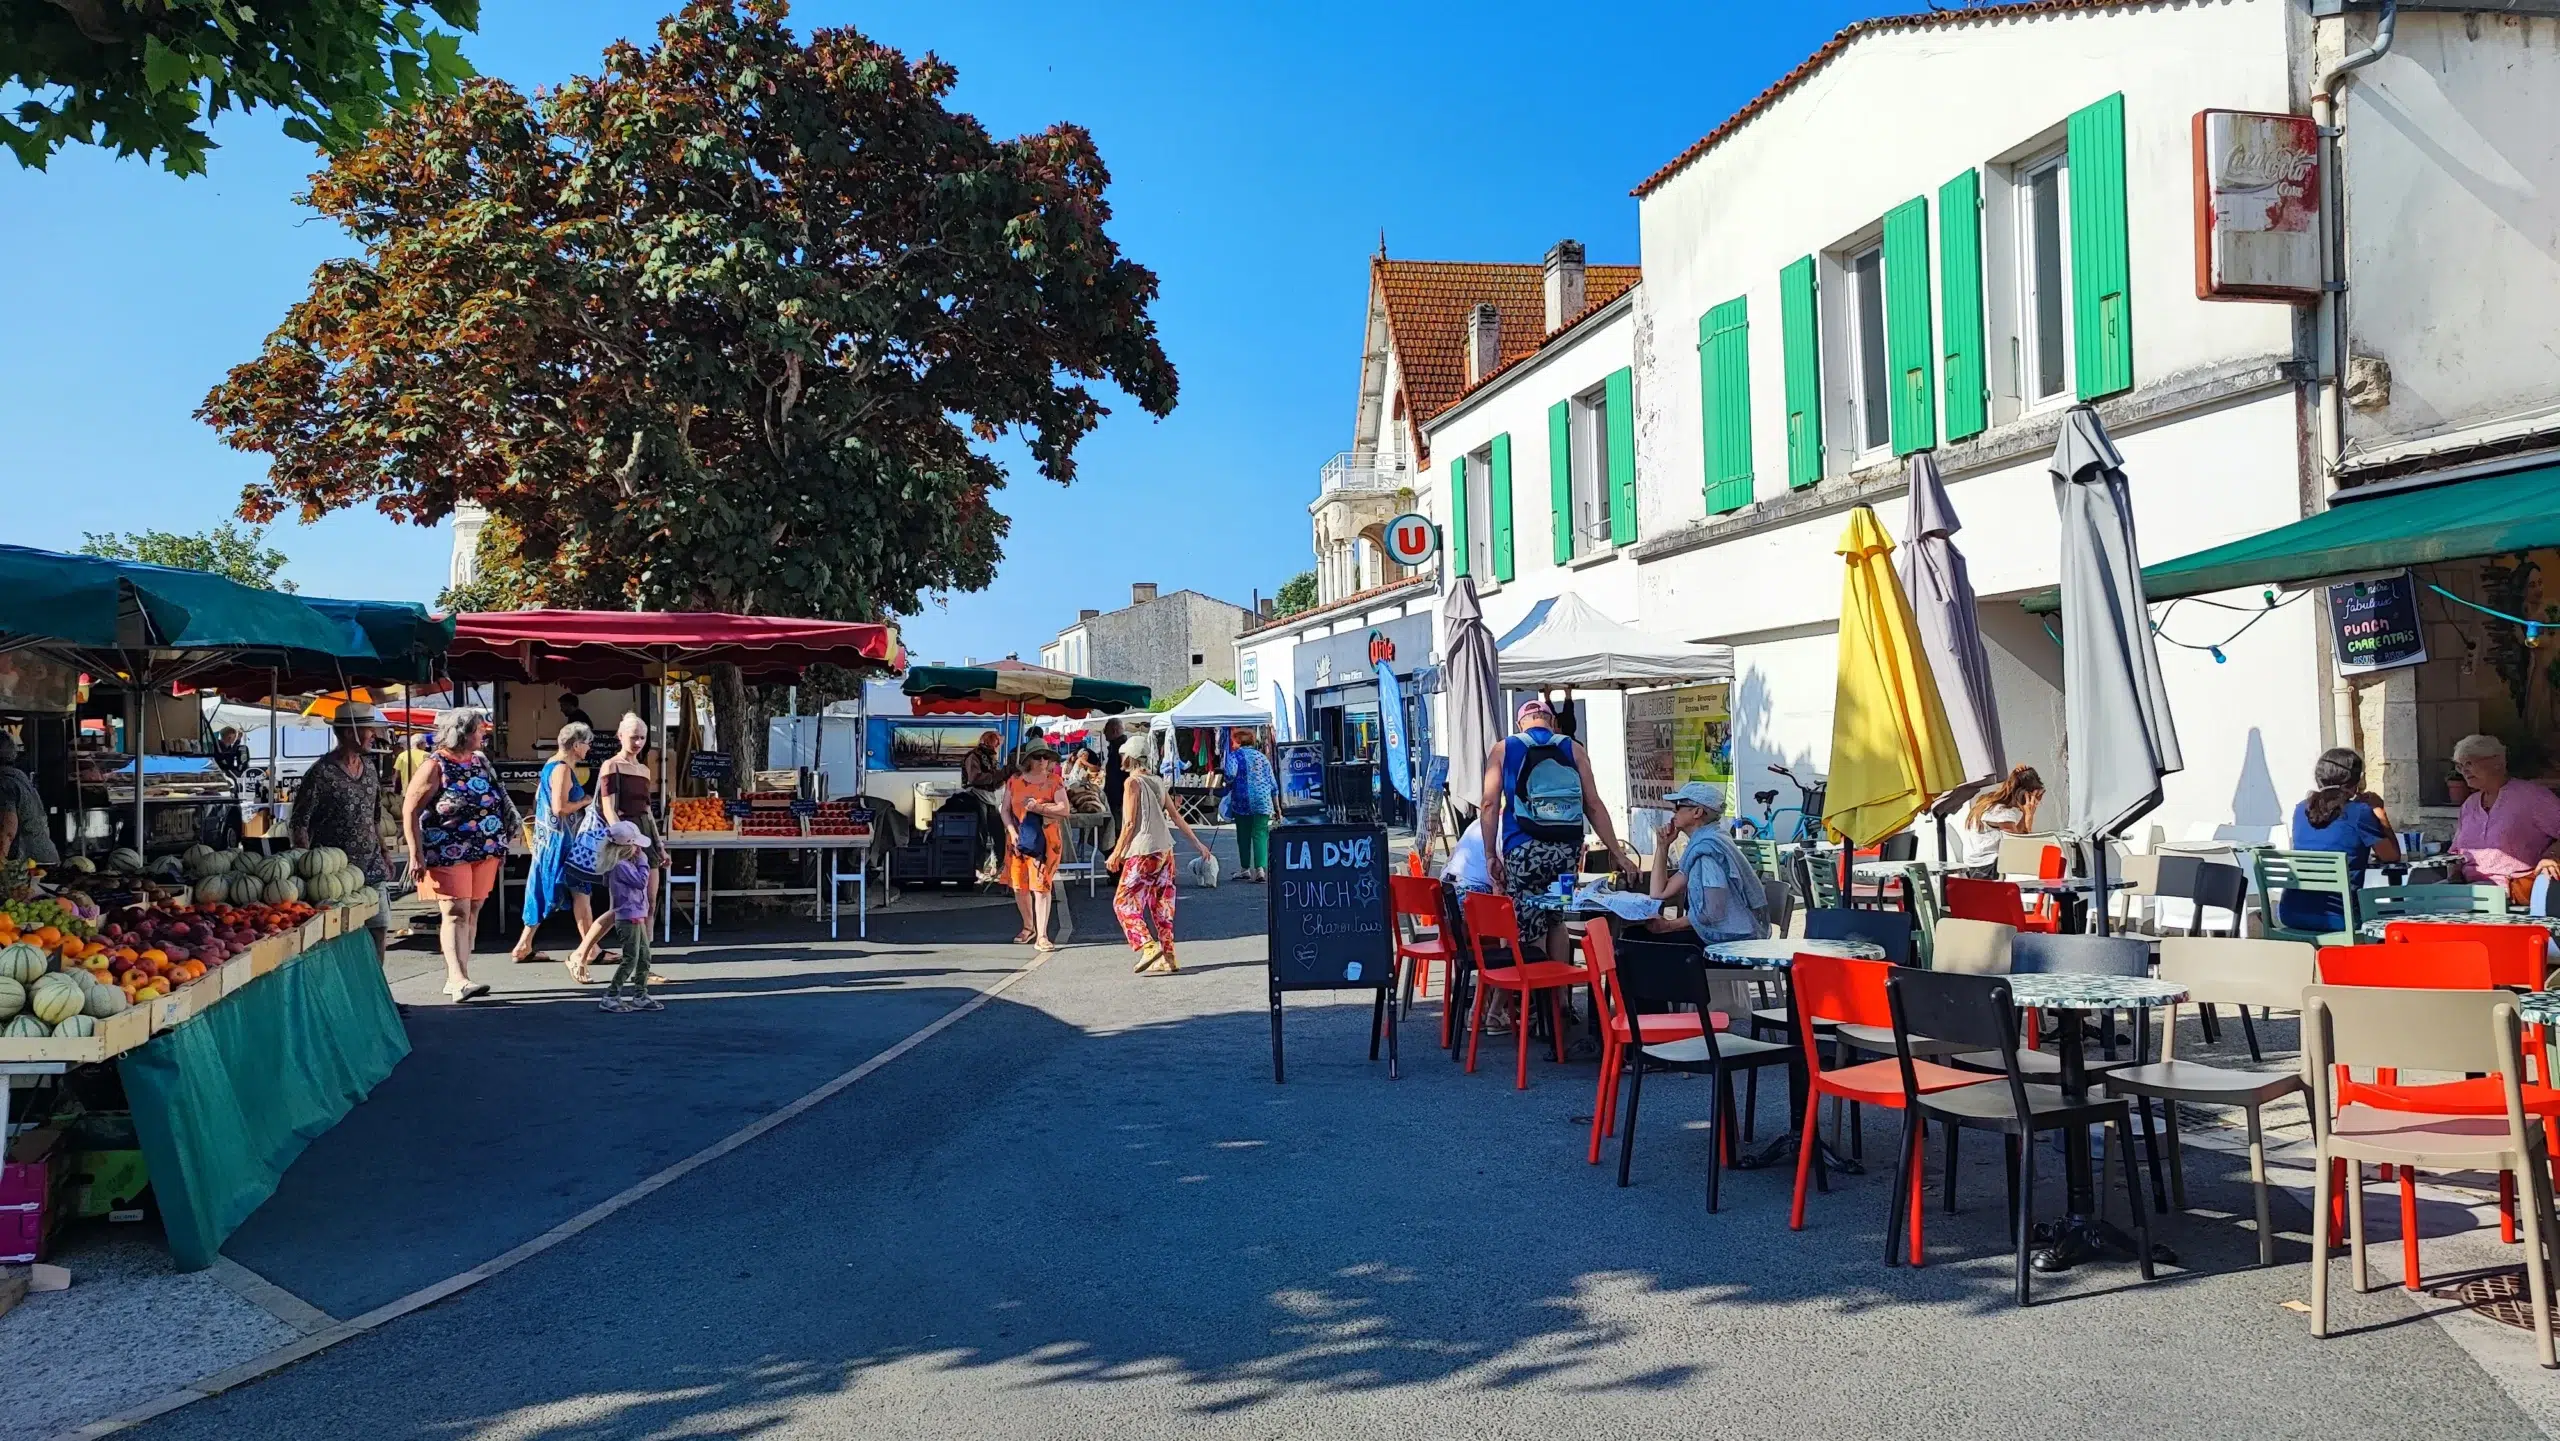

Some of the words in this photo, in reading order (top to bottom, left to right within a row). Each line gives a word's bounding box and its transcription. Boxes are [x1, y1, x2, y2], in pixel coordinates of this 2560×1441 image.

[1398, 526, 1425, 555] U
[1286, 841, 1312, 870] LA
[1282, 880, 1351, 909] PUNCH
